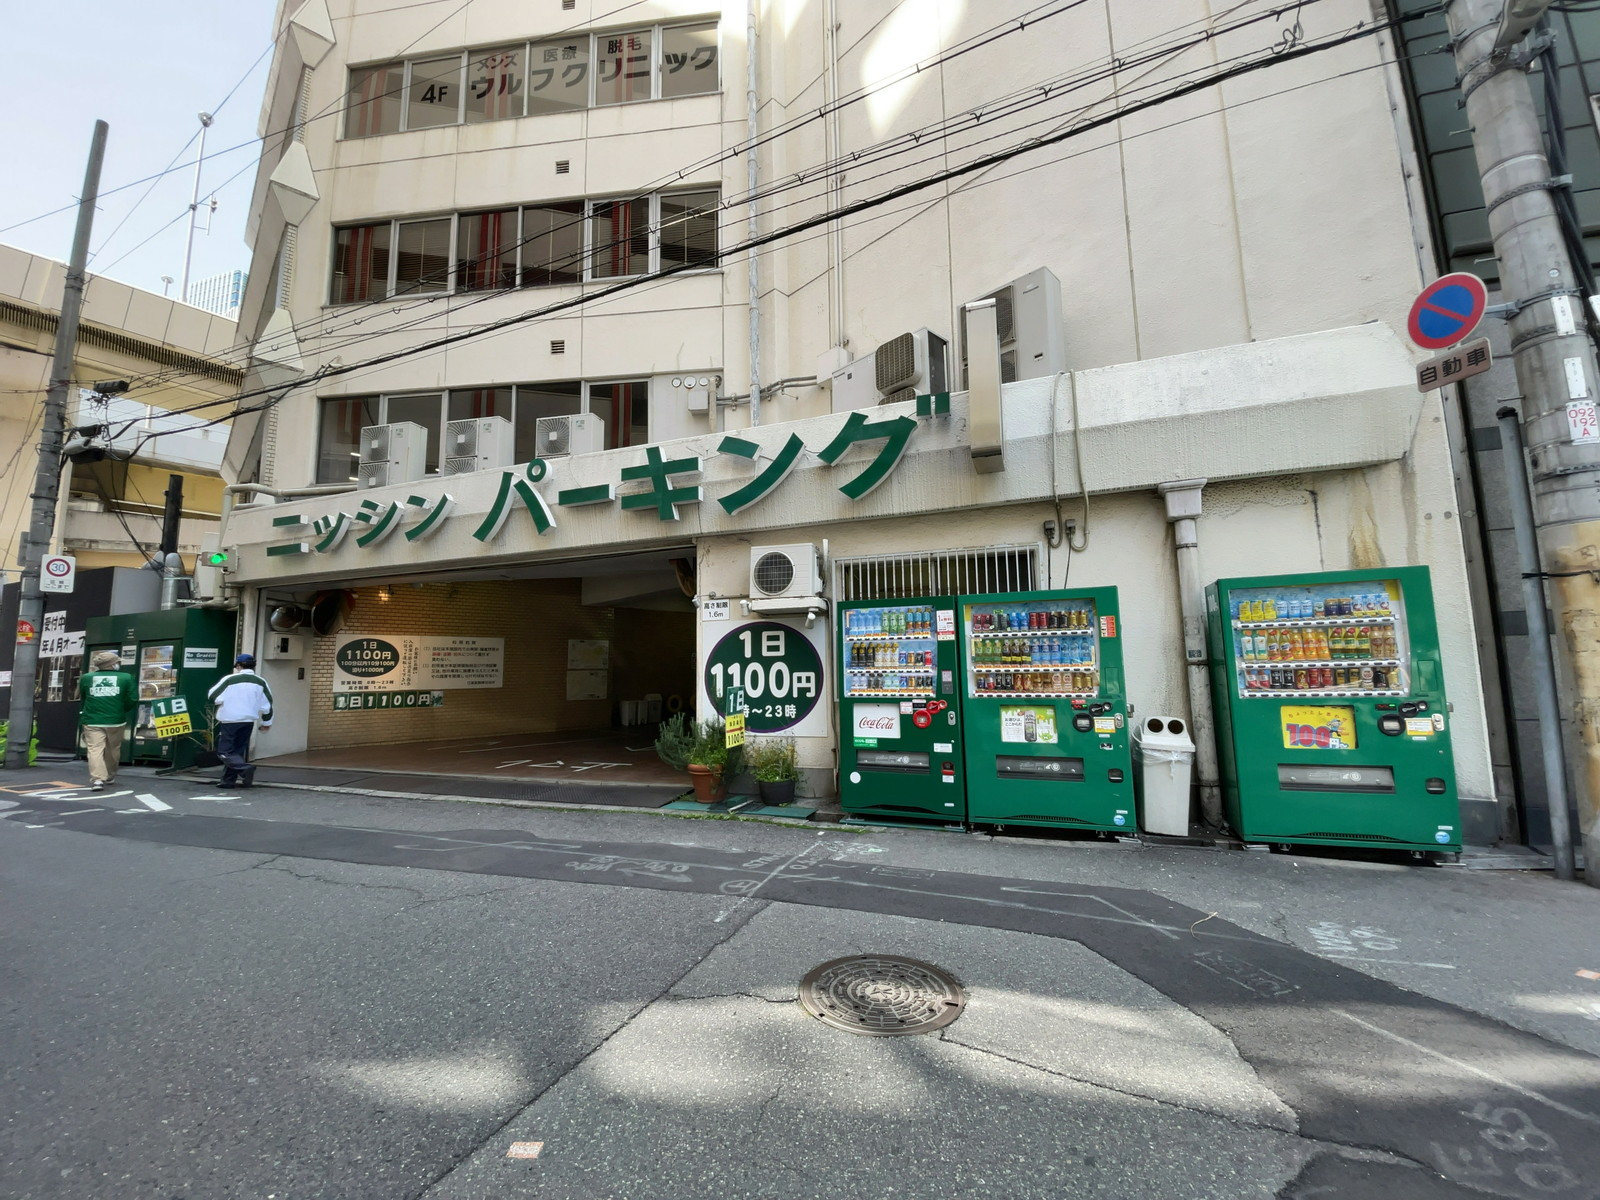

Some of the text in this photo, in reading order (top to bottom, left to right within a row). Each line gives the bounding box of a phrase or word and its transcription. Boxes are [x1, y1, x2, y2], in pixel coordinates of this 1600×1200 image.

[477, 36, 642, 72] メンズ 医療 脱毛
[420, 84, 448, 103] 4F
[1419, 348, 1487, 386] 自動車
[1568, 407, 1595, 419] 092
[1572, 417, 1597, 428] 192
[1582, 427, 1591, 437] A
[266, 391, 952, 557] ニッシン パーキング
[51, 563, 66, 573] 30
[703, 601, 729, 610] 高さ制限
[708, 610, 724, 618] 1.6m
[45, 615, 66, 632] 受付中
[362, 641, 377, 650] 1日
[739, 630, 785, 658] 1日
[346, 650, 392, 660] 1100円
[710, 661, 816, 698] 1100円
[157, 698, 188, 715] 1日
[729, 690, 744, 713] 1日
[160, 725, 190, 736] 1100円
